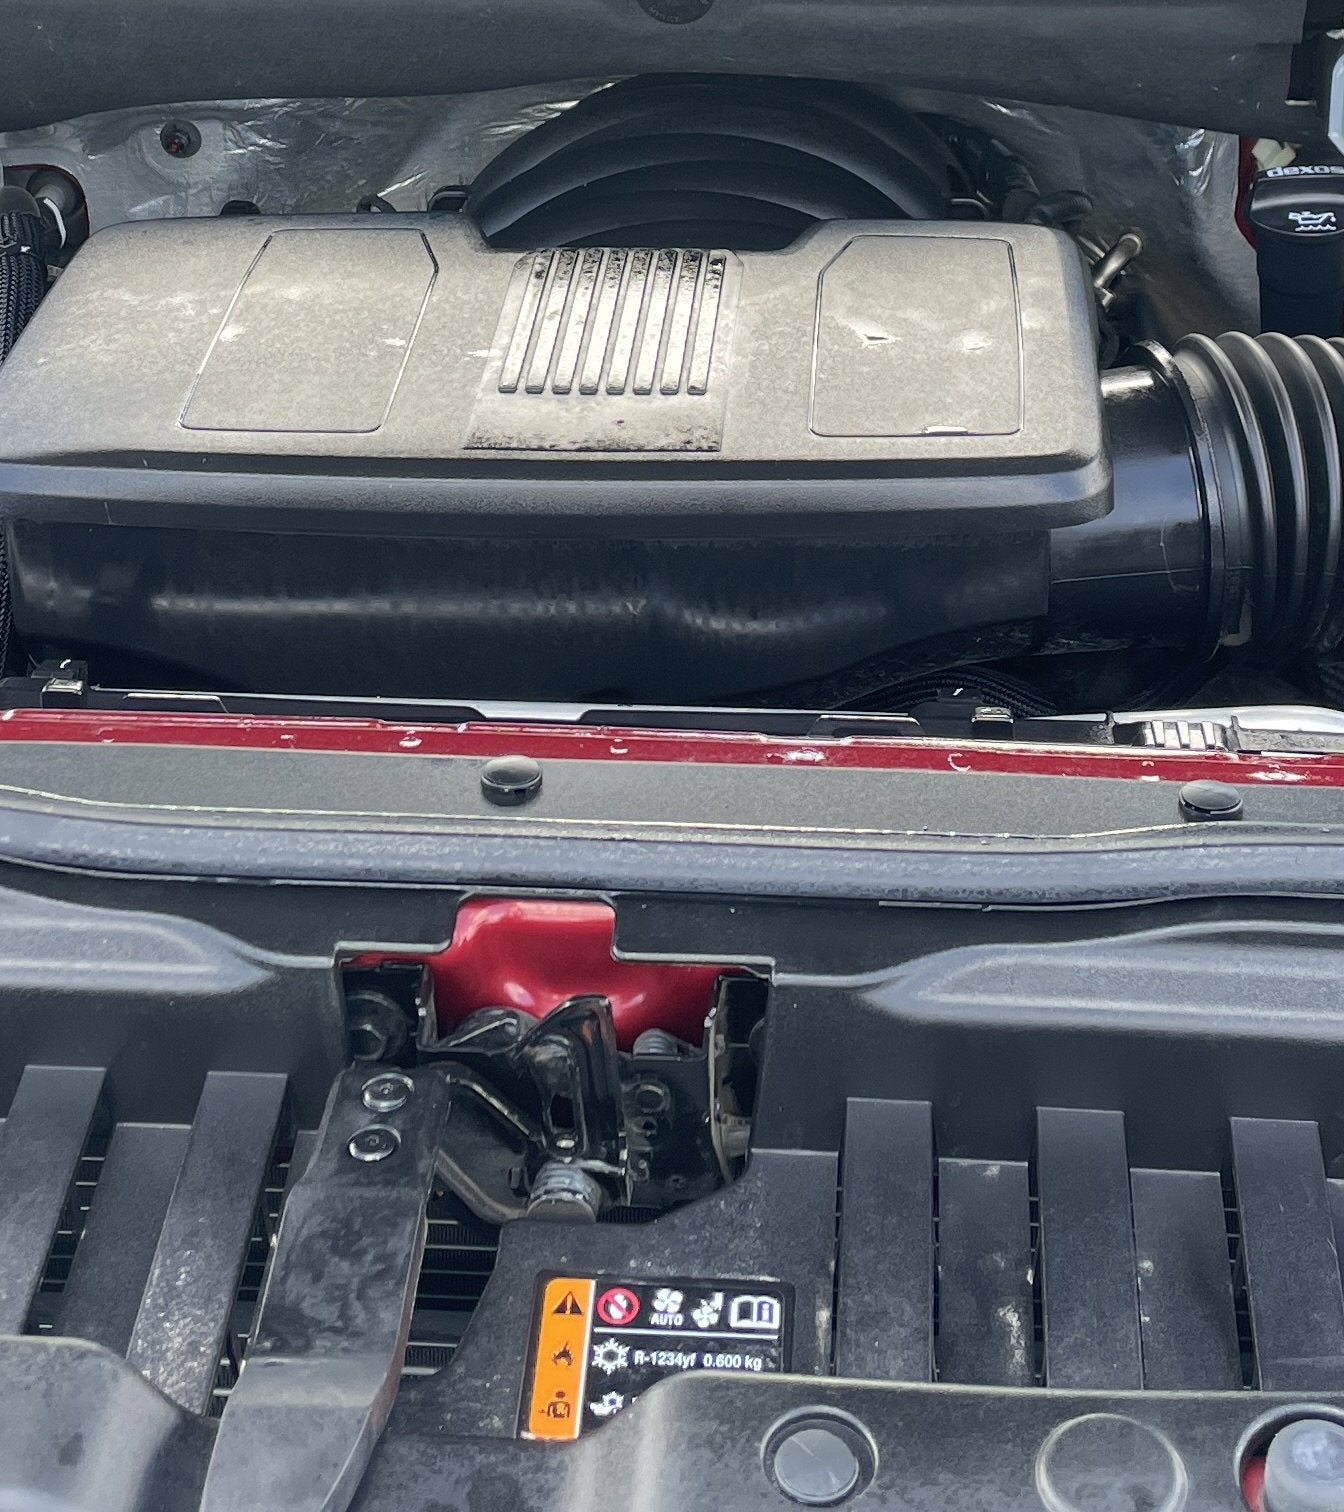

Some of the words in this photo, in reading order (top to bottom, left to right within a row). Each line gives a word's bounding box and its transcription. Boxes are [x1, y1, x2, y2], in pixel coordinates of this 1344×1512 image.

[650, 1314, 683, 1326] AUTO
[634, 1350, 697, 1369] R-1234yf
[703, 1353, 742, 1368] 0.600
[744, 1355, 762, 1371] kg
